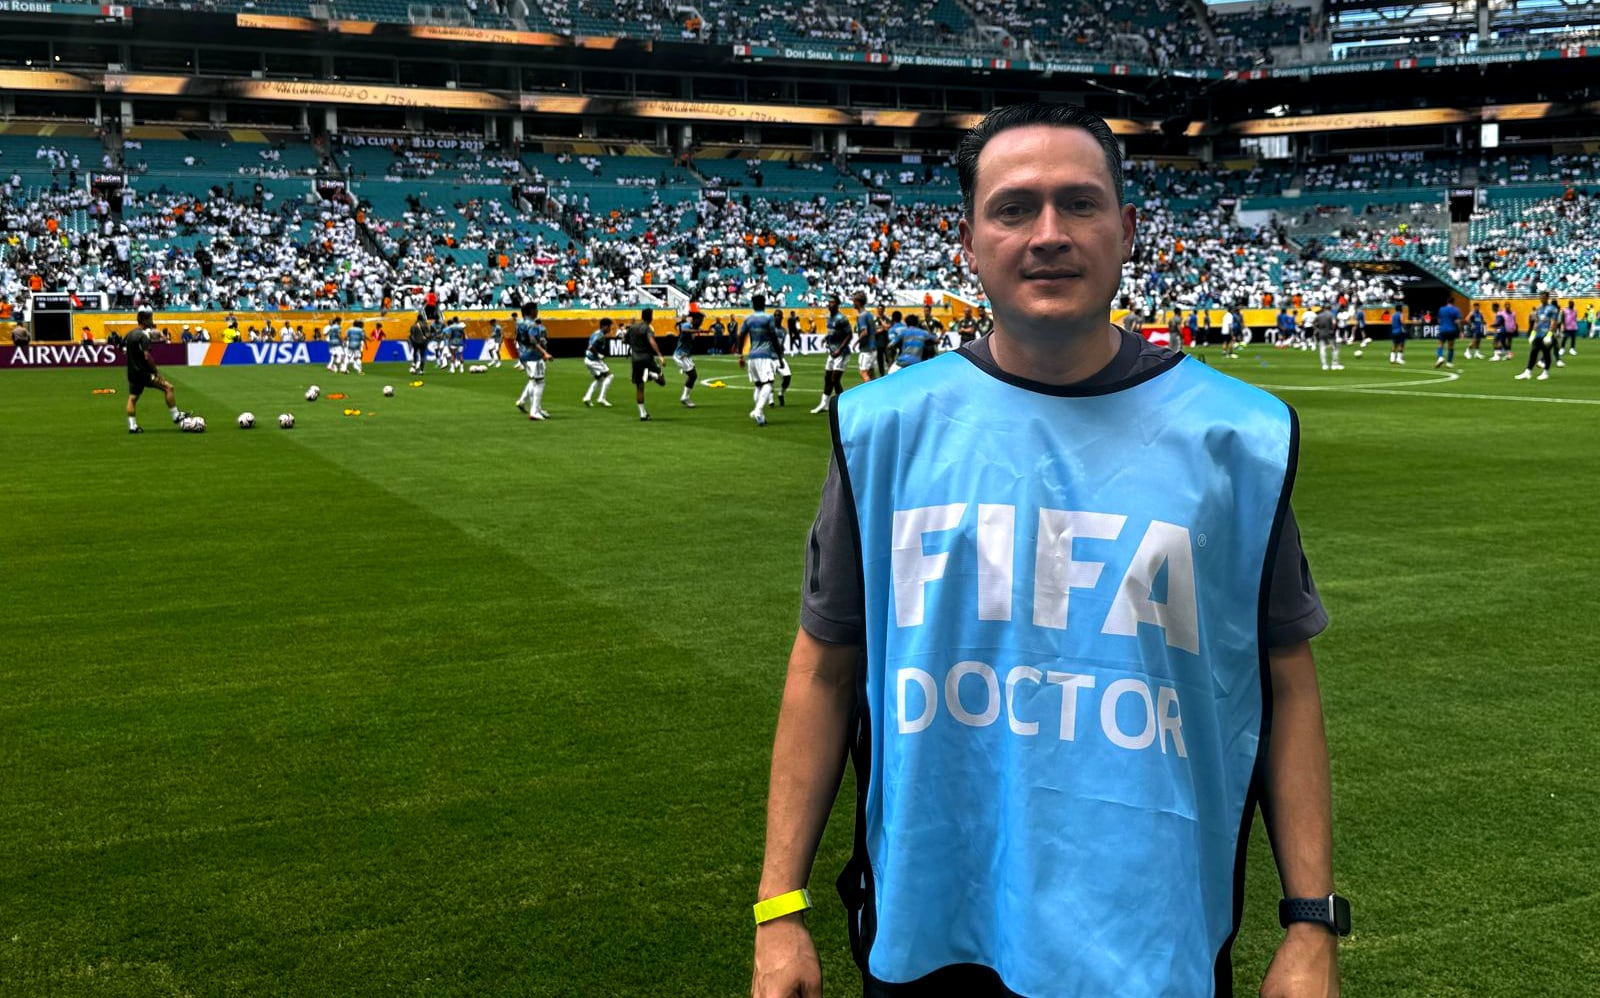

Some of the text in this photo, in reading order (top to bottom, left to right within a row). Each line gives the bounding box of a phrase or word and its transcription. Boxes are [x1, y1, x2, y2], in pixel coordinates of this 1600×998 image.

[11, 1, 52, 13] ROBBIE
[785, 48, 806, 58] DON
[807, 50, 833, 60] SHULA
[894, 55, 983, 68] NICK BUONICONTI 85
[1435, 51, 1541, 66] BOB KUECHENBERG 67
[1029, 61, 1044, 71] BILL
[1273, 68, 1309, 78] DWIGHT
[1312, 63, 1370, 76] STEPHENSON
[436, 140, 458, 149] CUP
[11, 344, 117, 365] AIRWAYS
[246, 343, 311, 363] VISA
[891, 502, 1200, 656] FIFA
[896, 660, 1188, 758] DOCTOR
